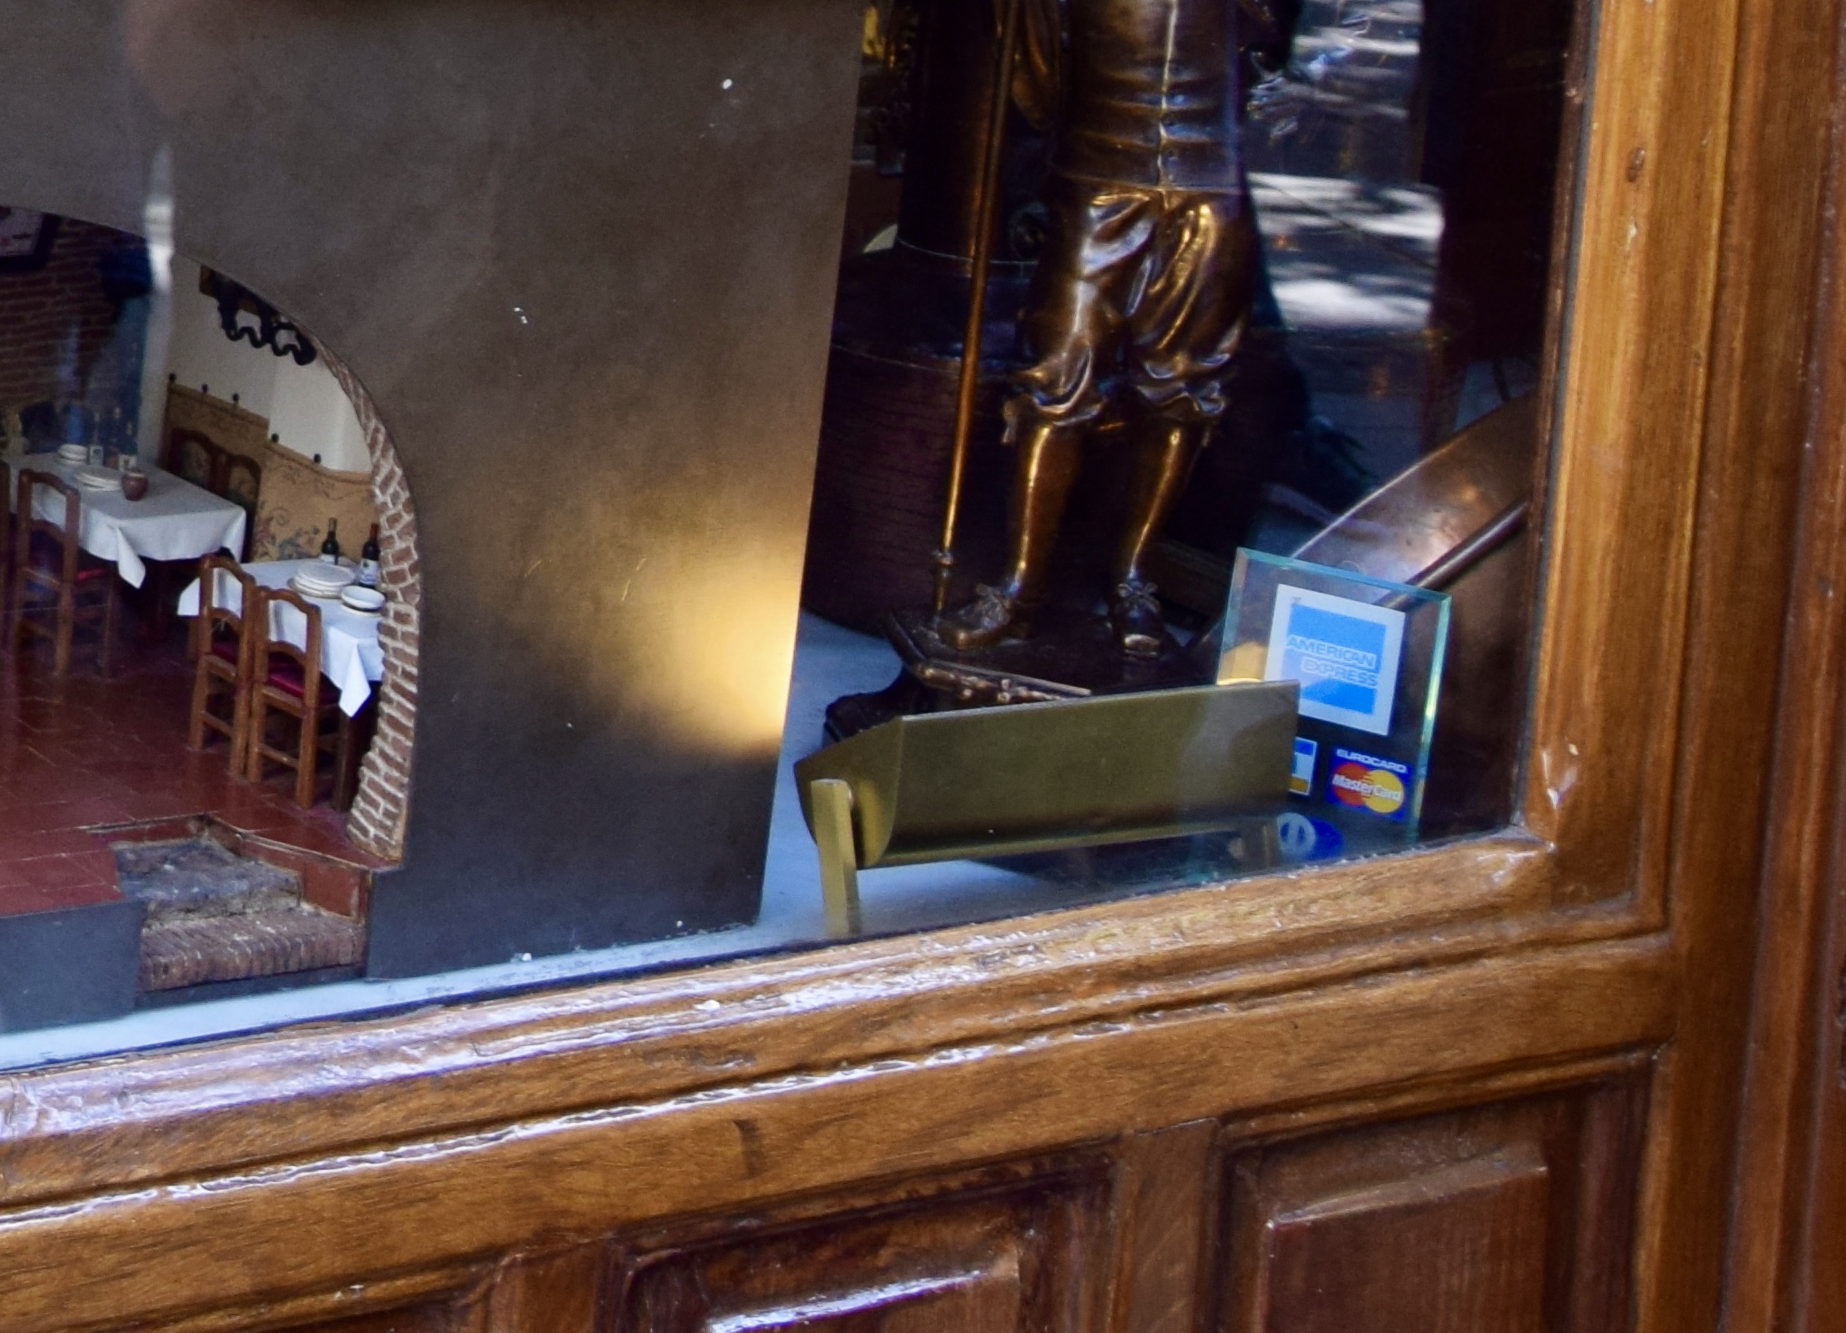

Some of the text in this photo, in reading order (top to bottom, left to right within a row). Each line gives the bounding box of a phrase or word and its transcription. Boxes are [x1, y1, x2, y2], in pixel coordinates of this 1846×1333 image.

[1287, 635, 1377, 670] AMERICAN
[1300, 656, 1379, 690] EXPRESS
[1335, 748, 1408, 774] EUROCARD
[1331, 773, 1405, 804] MasterCard
